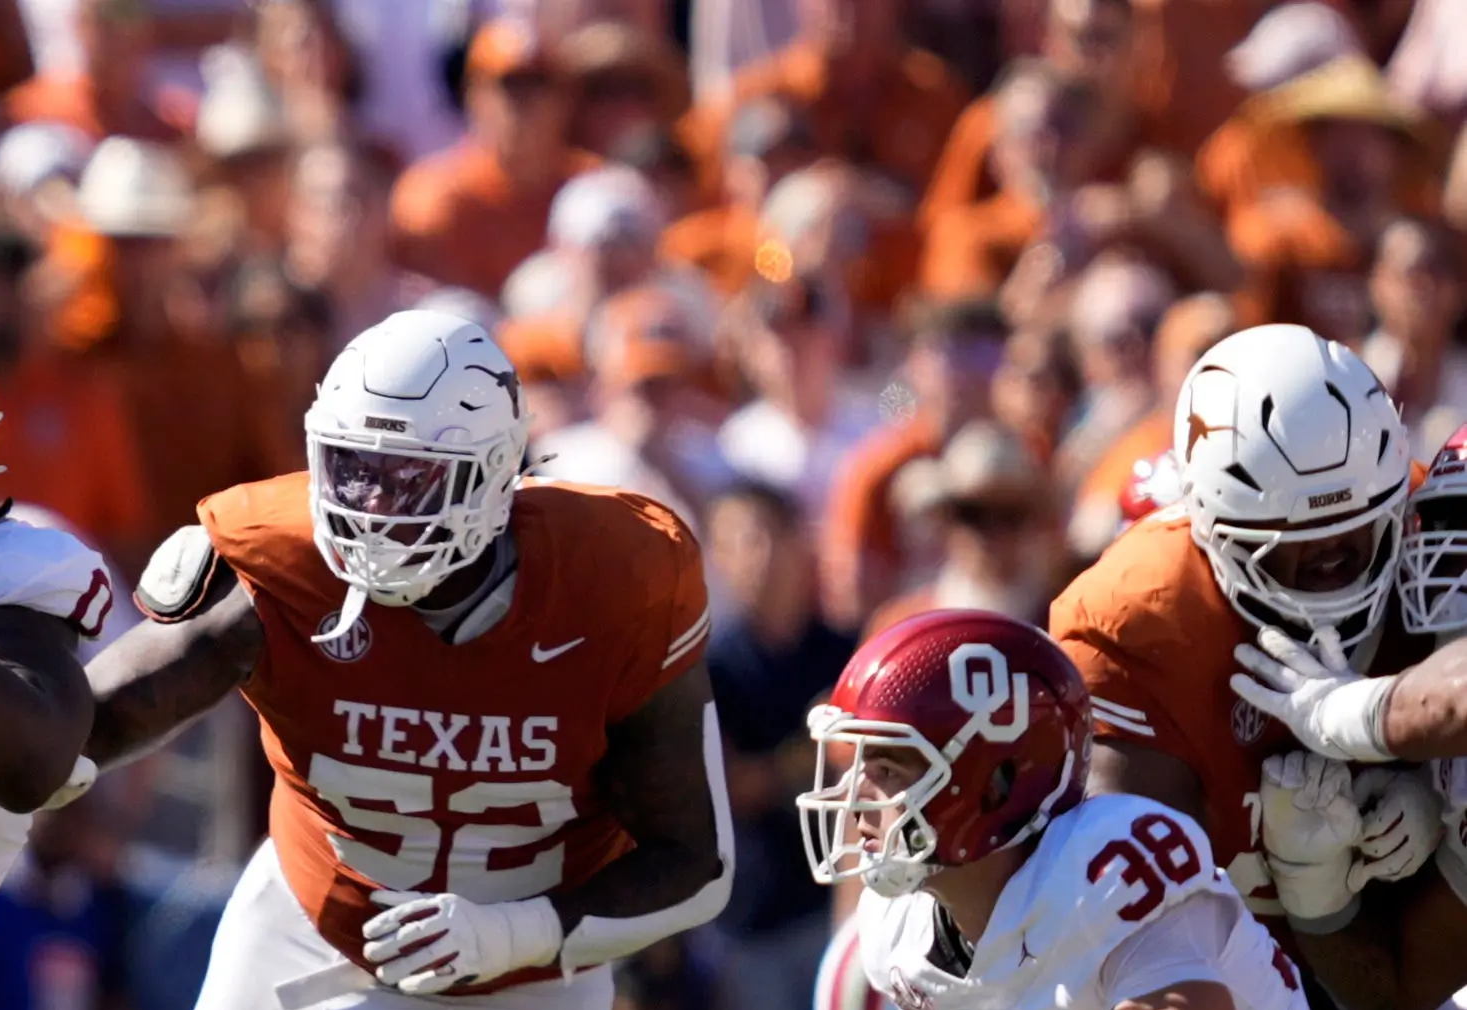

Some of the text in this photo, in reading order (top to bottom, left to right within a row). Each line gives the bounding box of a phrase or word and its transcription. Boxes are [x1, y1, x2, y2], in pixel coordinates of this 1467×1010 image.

[1308, 488, 1353, 509] HORNS
[66, 567, 113, 637] 0
[334, 699, 559, 772] TEXAS
[948, 643, 1030, 743] OU
[308, 752, 578, 906] 52
[1087, 813, 1202, 922] 38
